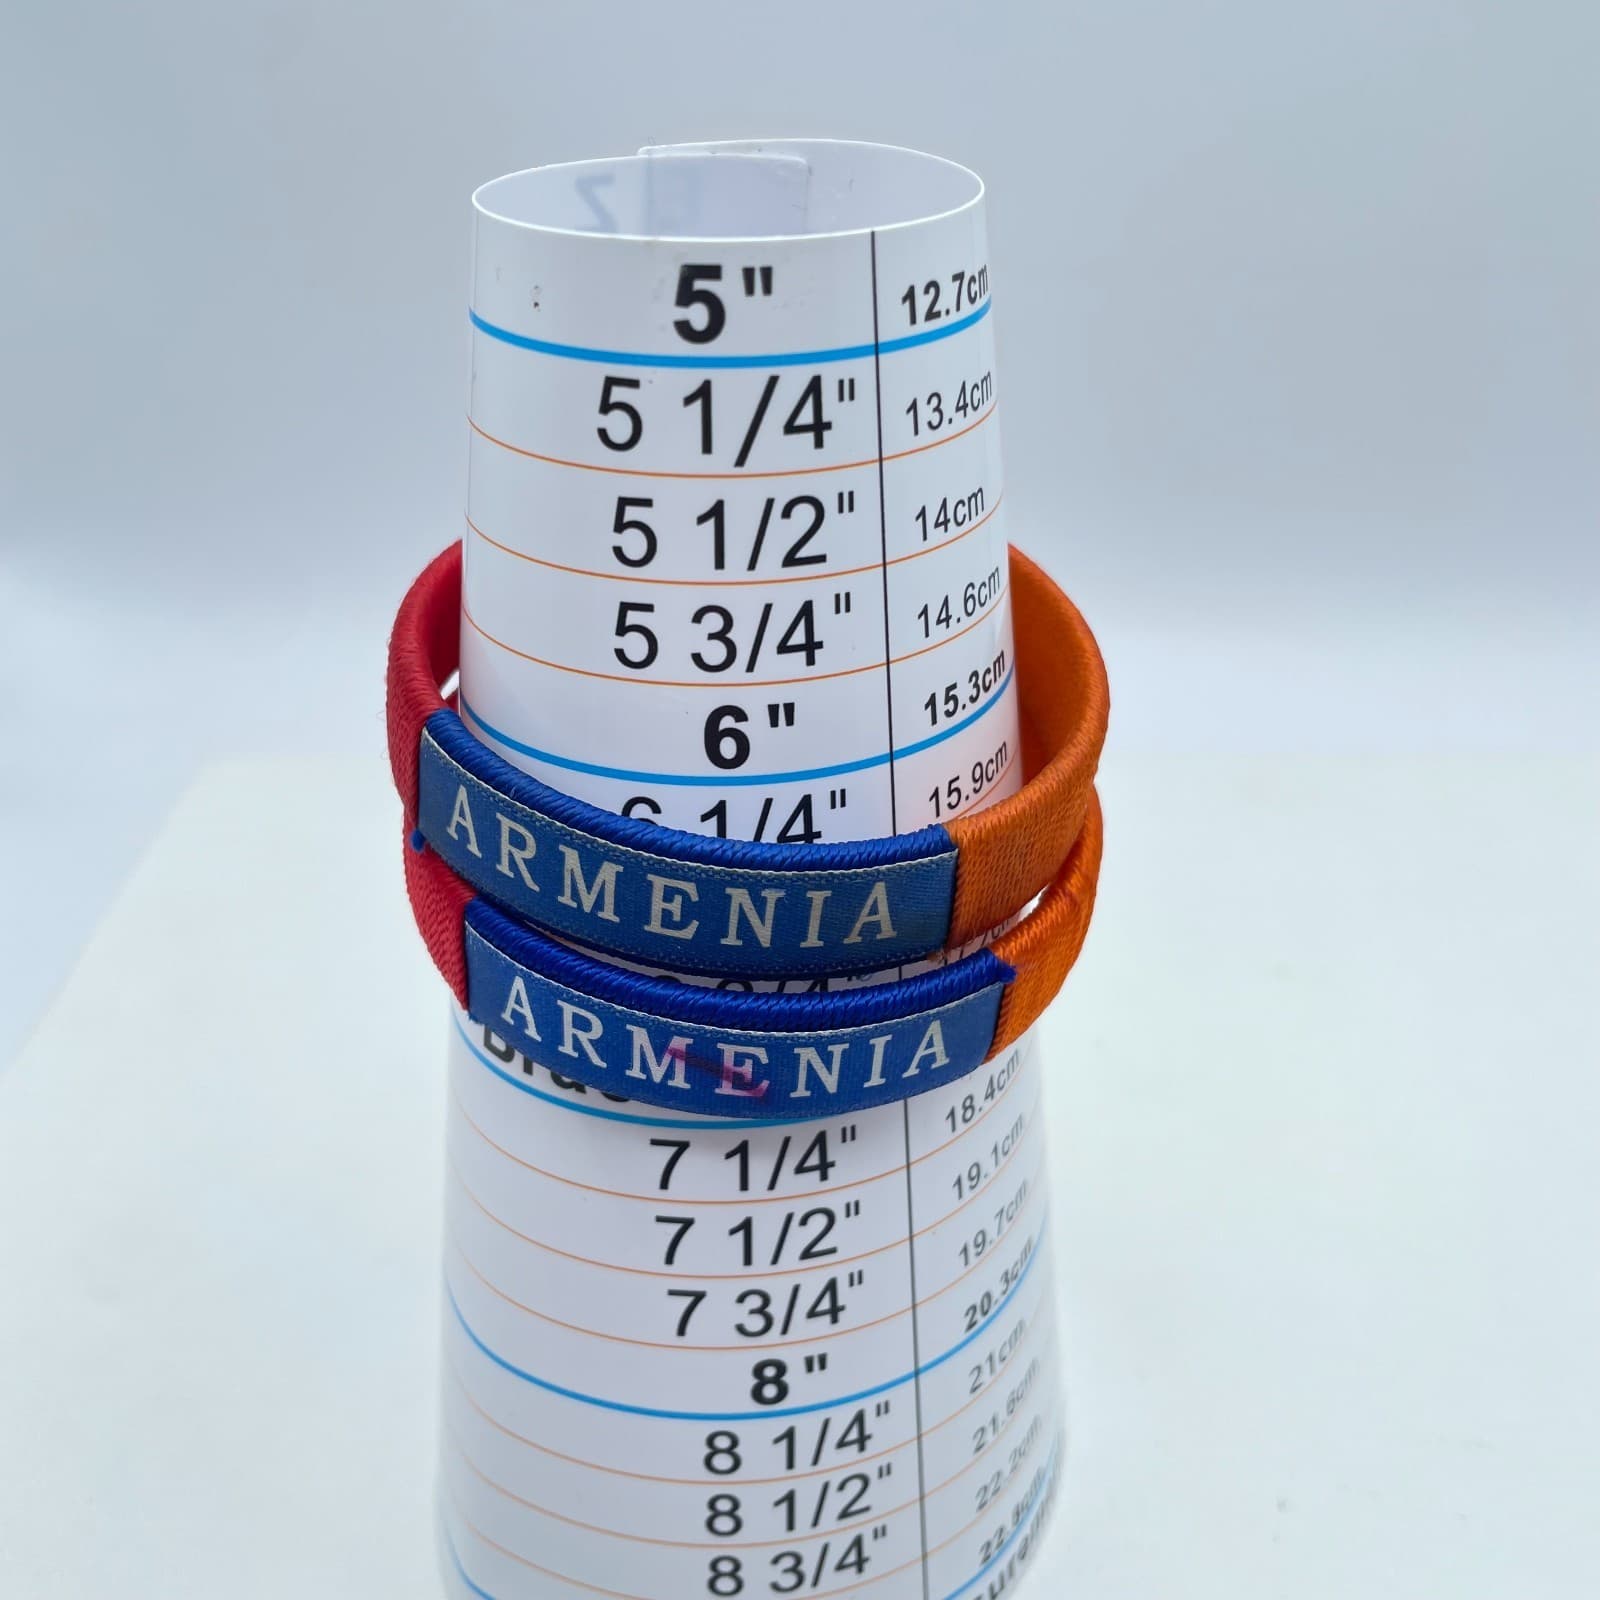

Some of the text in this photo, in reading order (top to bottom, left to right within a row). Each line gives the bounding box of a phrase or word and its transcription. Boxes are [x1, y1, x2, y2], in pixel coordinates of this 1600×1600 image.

[673, 264, 774, 344] 5"
[901, 264, 990, 326] 12.7cm
[597, 375, 855, 467] 5 1/4"
[906, 370, 993, 436] 13.4cm
[612, 491, 854, 571] 5 1/2"
[914, 486, 985, 542] 14cm
[613, 592, 851, 673] 5 3/4"
[917, 566, 1001, 638] 14.6cm
[924, 649, 1006, 726] 15.3cm
[704, 702, 796, 770] 6"
[929, 740, 1008, 818] 15.9cm
[446, 784, 898, 948] ARMENIA
[501, 975, 950, 1099] ARMENIA
[945, 1049, 1020, 1133] 18.4cm
[650, 1124, 856, 1191] 7 1/4"
[952, 1113, 1024, 1200] 19.1cm
[655, 1200, 860, 1266] 7 1/2"
[958, 1177, 1027, 1267] 19.7cm
[667, 1269, 864, 1337] 7 3/4"
[964, 1236, 1033, 1331] 20.3cm
[750, 1353, 828, 1405] 8"
[969, 1318, 1025, 1394] 21cm
[704, 1400, 890, 1475] 8 1/4"
[705, 1462, 892, 1537] 8 1/2"
[707, 1524, 887, 1597] 8 3/4"
